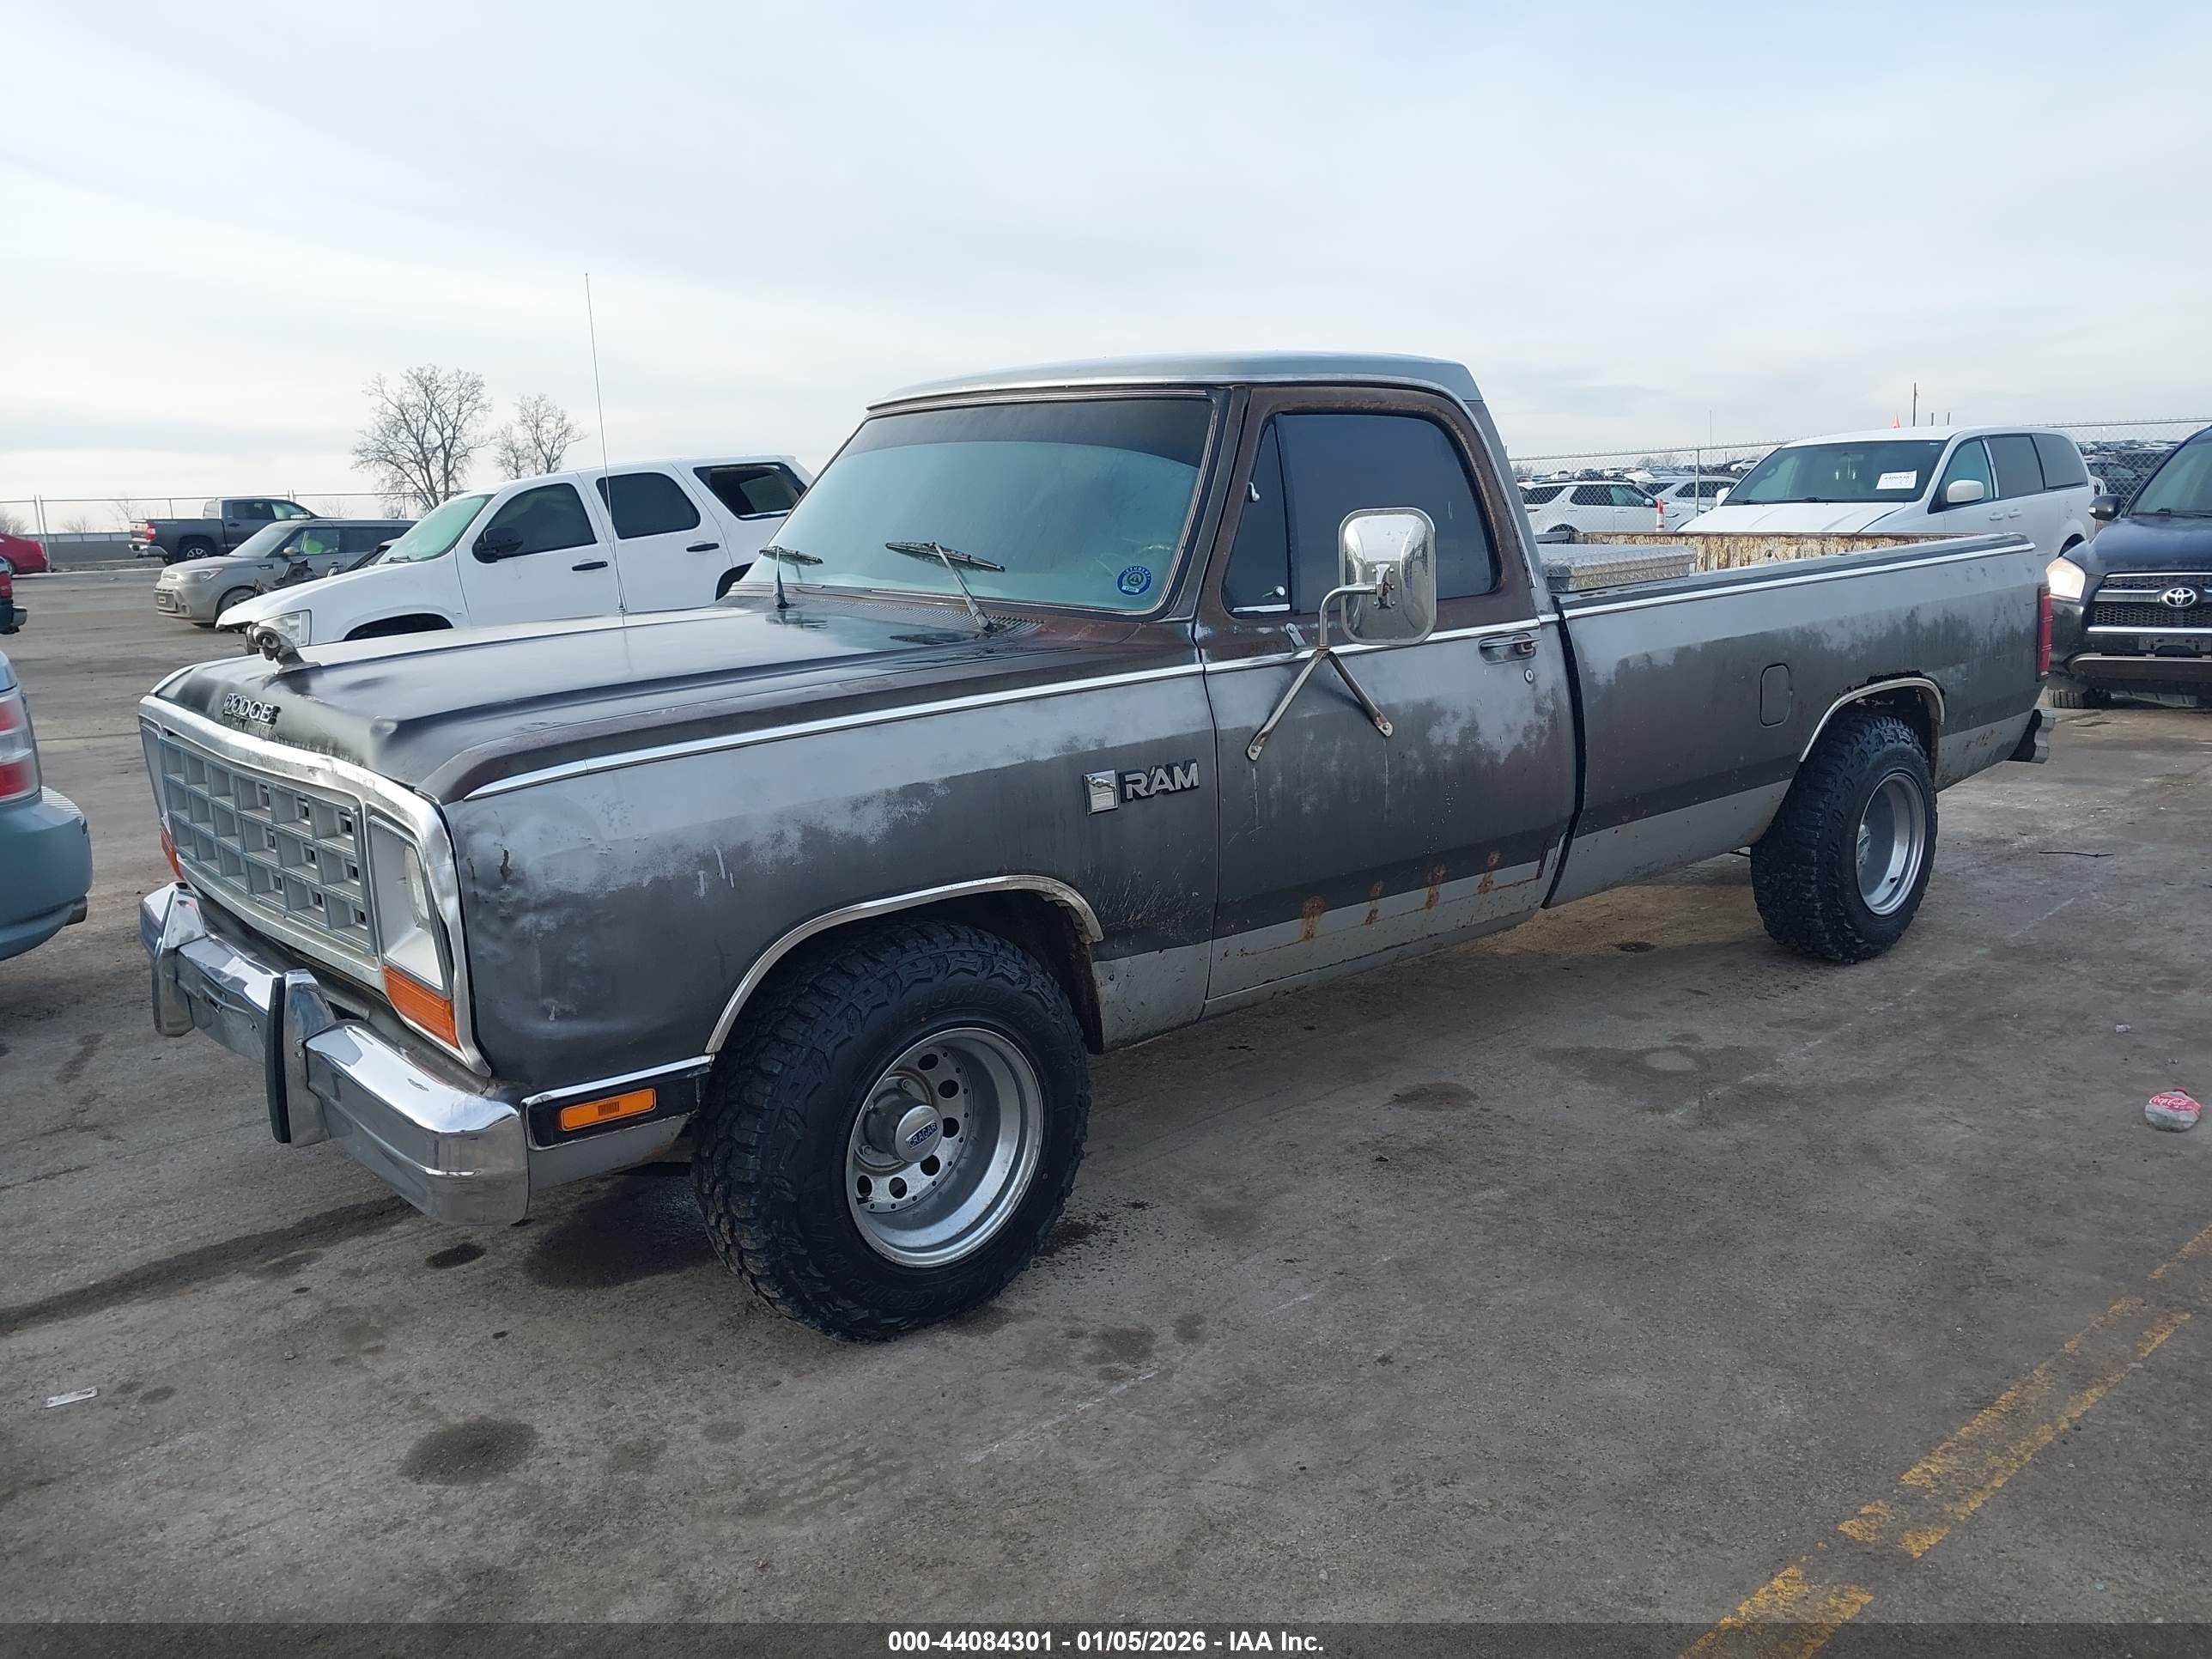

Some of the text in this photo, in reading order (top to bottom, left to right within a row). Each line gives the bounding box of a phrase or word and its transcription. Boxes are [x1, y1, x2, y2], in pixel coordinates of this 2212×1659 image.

[223, 693, 275, 722] DODGE
[1123, 762, 1200, 799] RAM
[908, 1123, 937, 1147] CRAGAR
